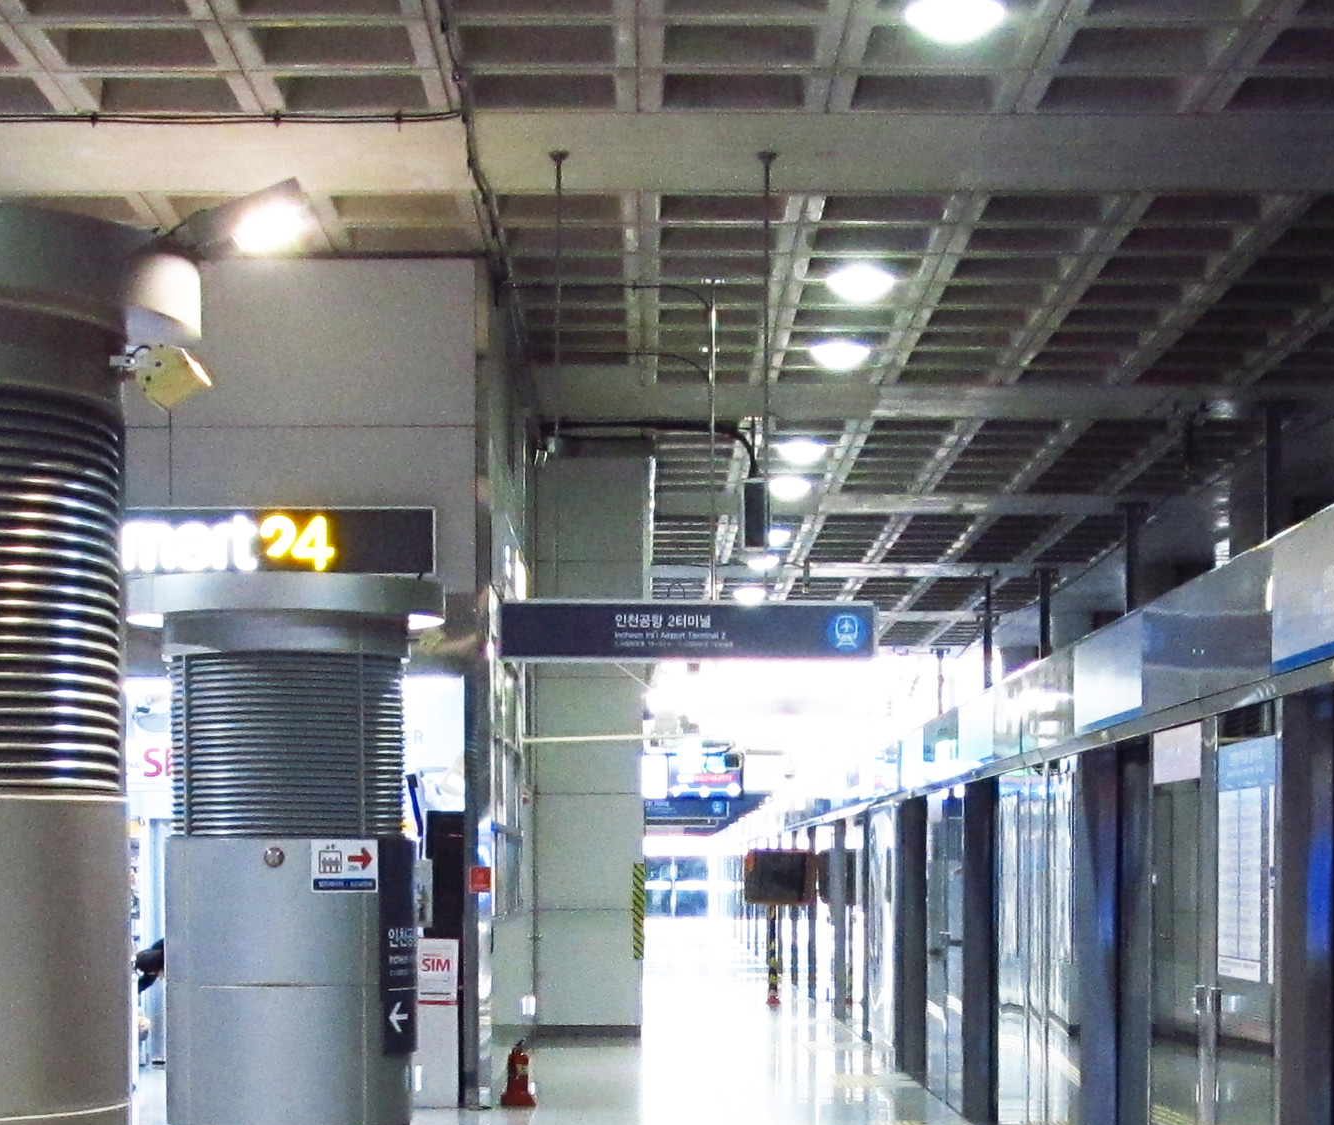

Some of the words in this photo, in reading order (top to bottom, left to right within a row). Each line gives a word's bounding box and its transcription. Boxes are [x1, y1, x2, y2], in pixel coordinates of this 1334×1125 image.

[614, 613, 663, 629] 인천공항
[667, 613, 711, 629] 2터미널
[421, 958, 451, 972] SIM
